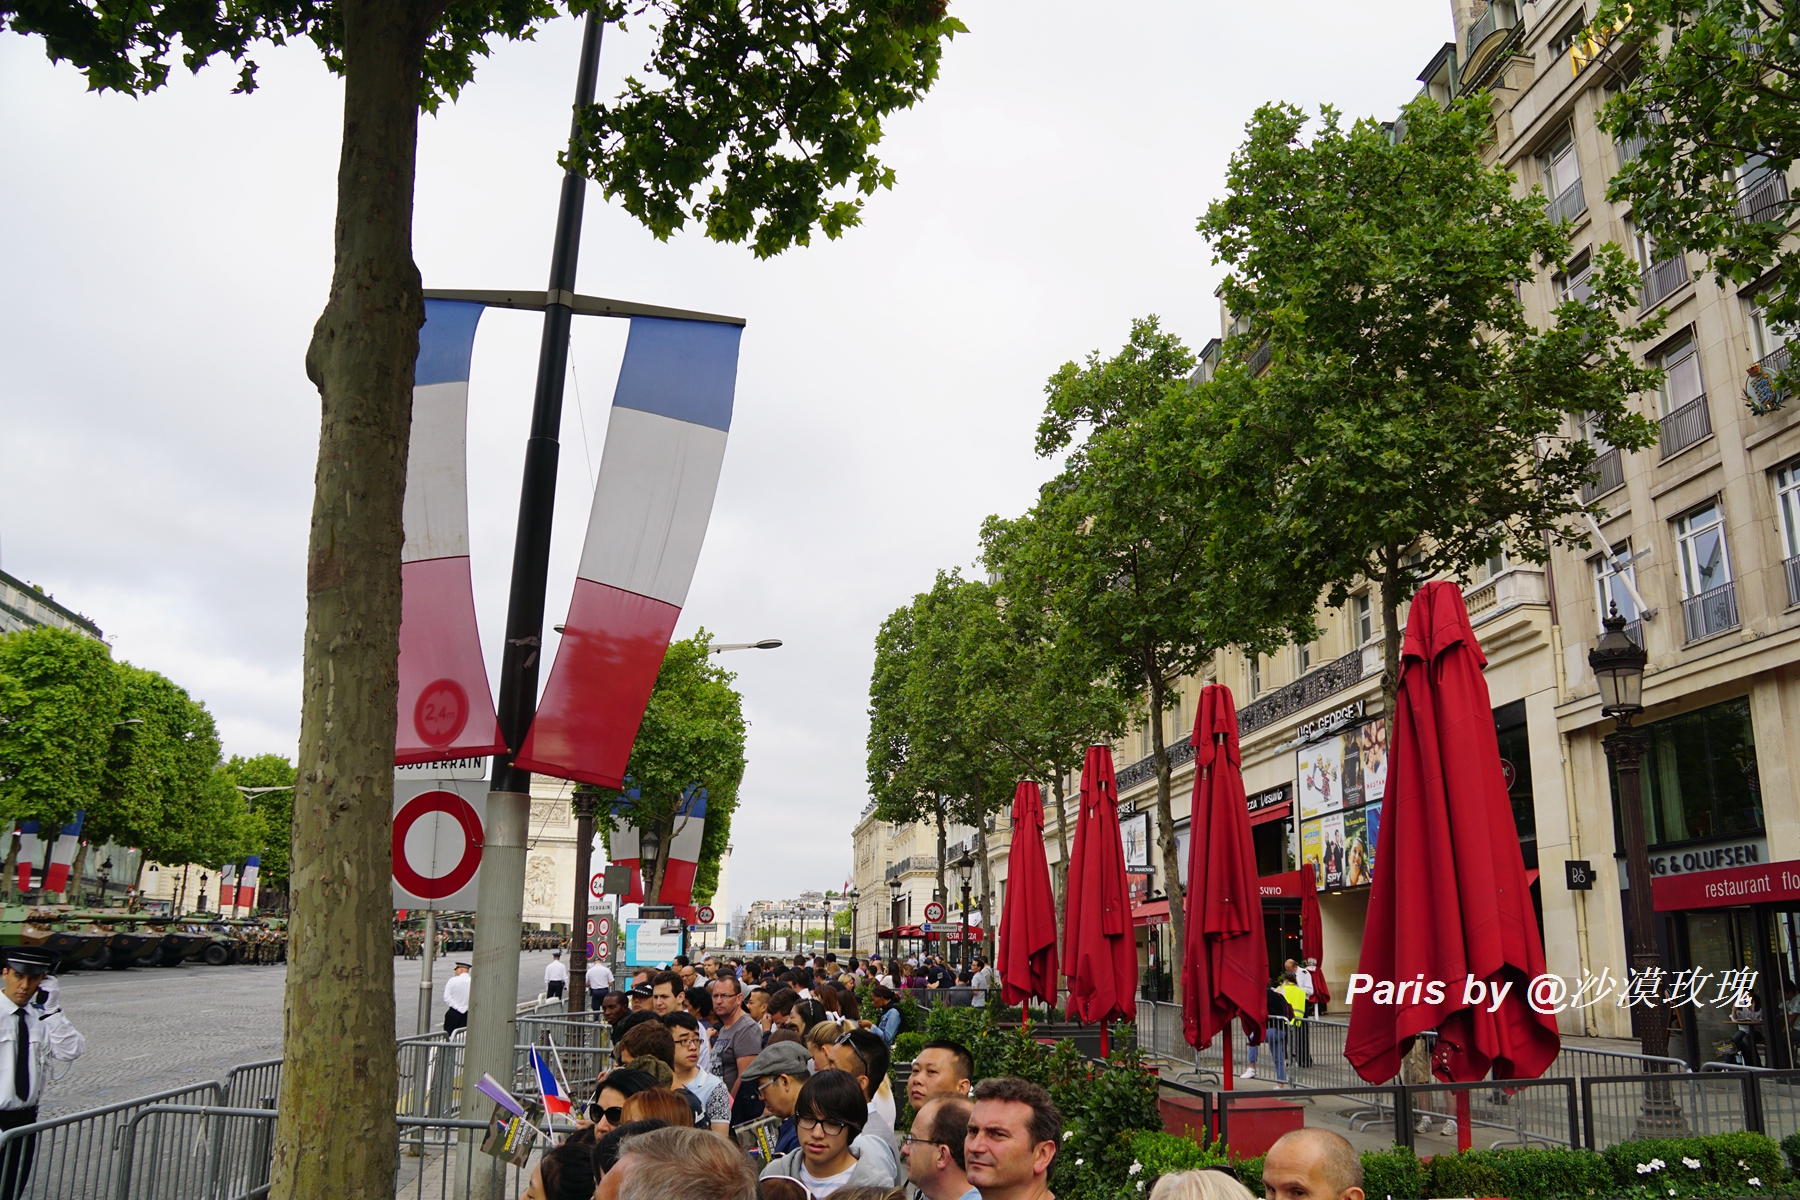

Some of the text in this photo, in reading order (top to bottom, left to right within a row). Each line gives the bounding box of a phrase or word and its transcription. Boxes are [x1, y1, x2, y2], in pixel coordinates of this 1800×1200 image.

[425, 703, 455, 723] 2,4m
[1318, 704, 1355, 730] GEORGE
[1357, 700, 1366, 717] V
[1683, 844, 1758, 871] OLUFSEN
[1327, 872, 1342, 883] SPY
[1705, 873, 1770, 898] restaurant
[1260, 886, 1282, 895] SUVIO
